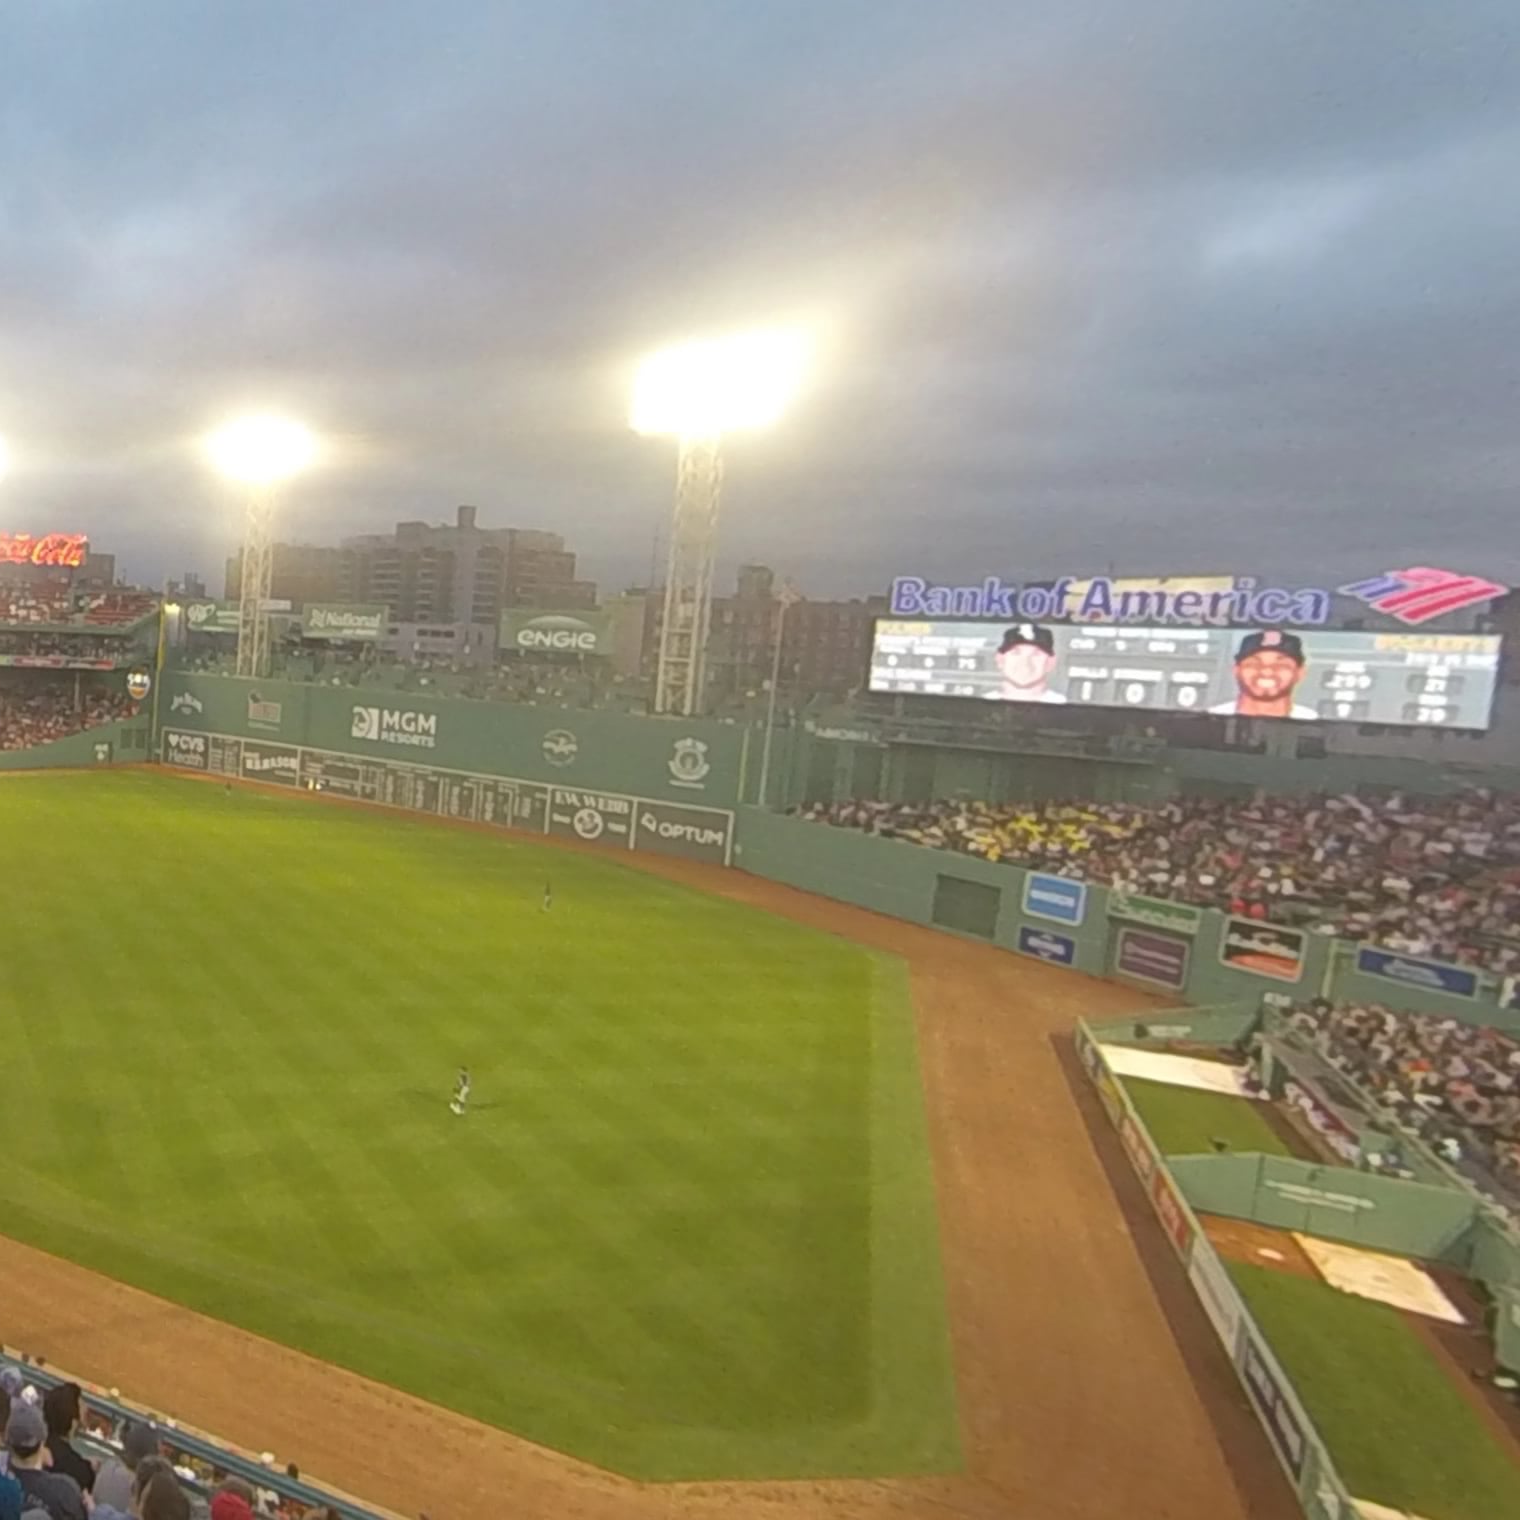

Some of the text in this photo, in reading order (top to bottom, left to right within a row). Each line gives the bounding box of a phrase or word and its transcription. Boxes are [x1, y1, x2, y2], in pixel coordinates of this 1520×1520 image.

[890, 576, 1329, 625] Bank of America
[327, 612, 382, 627] National
[382, 709, 437, 735] MGM
[180, 734, 205, 752] CVS
[380, 731, 436, 748] RESORTS
[168, 749, 204, 768] Health
[658, 822, 724, 846] OPTUM
